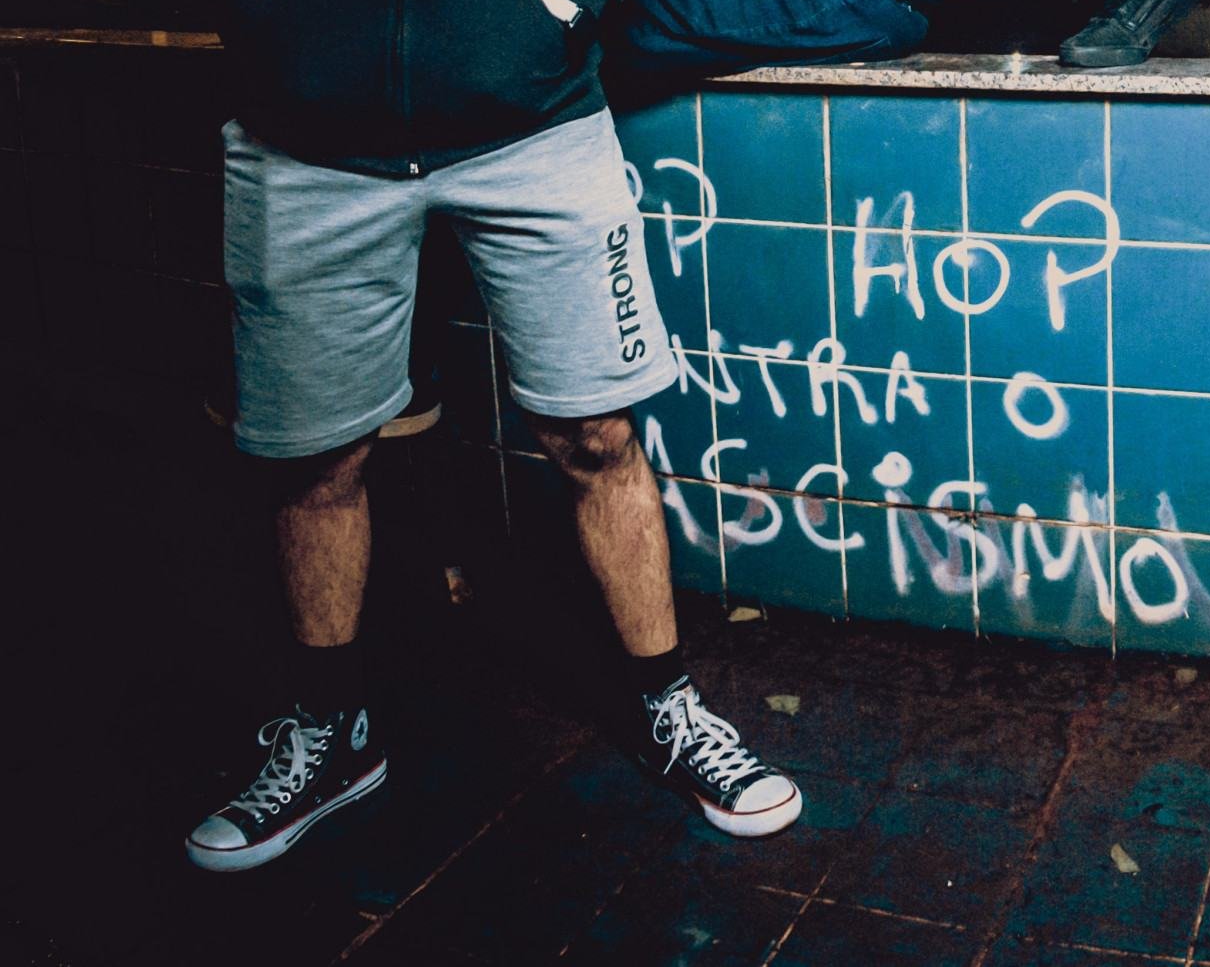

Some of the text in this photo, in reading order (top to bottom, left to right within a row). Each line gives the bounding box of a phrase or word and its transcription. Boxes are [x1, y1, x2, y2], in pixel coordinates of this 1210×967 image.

[606, 222, 646, 364] STRONG
[852, 190, 1120, 332] HOP
[1003, 372, 1070, 440] O
